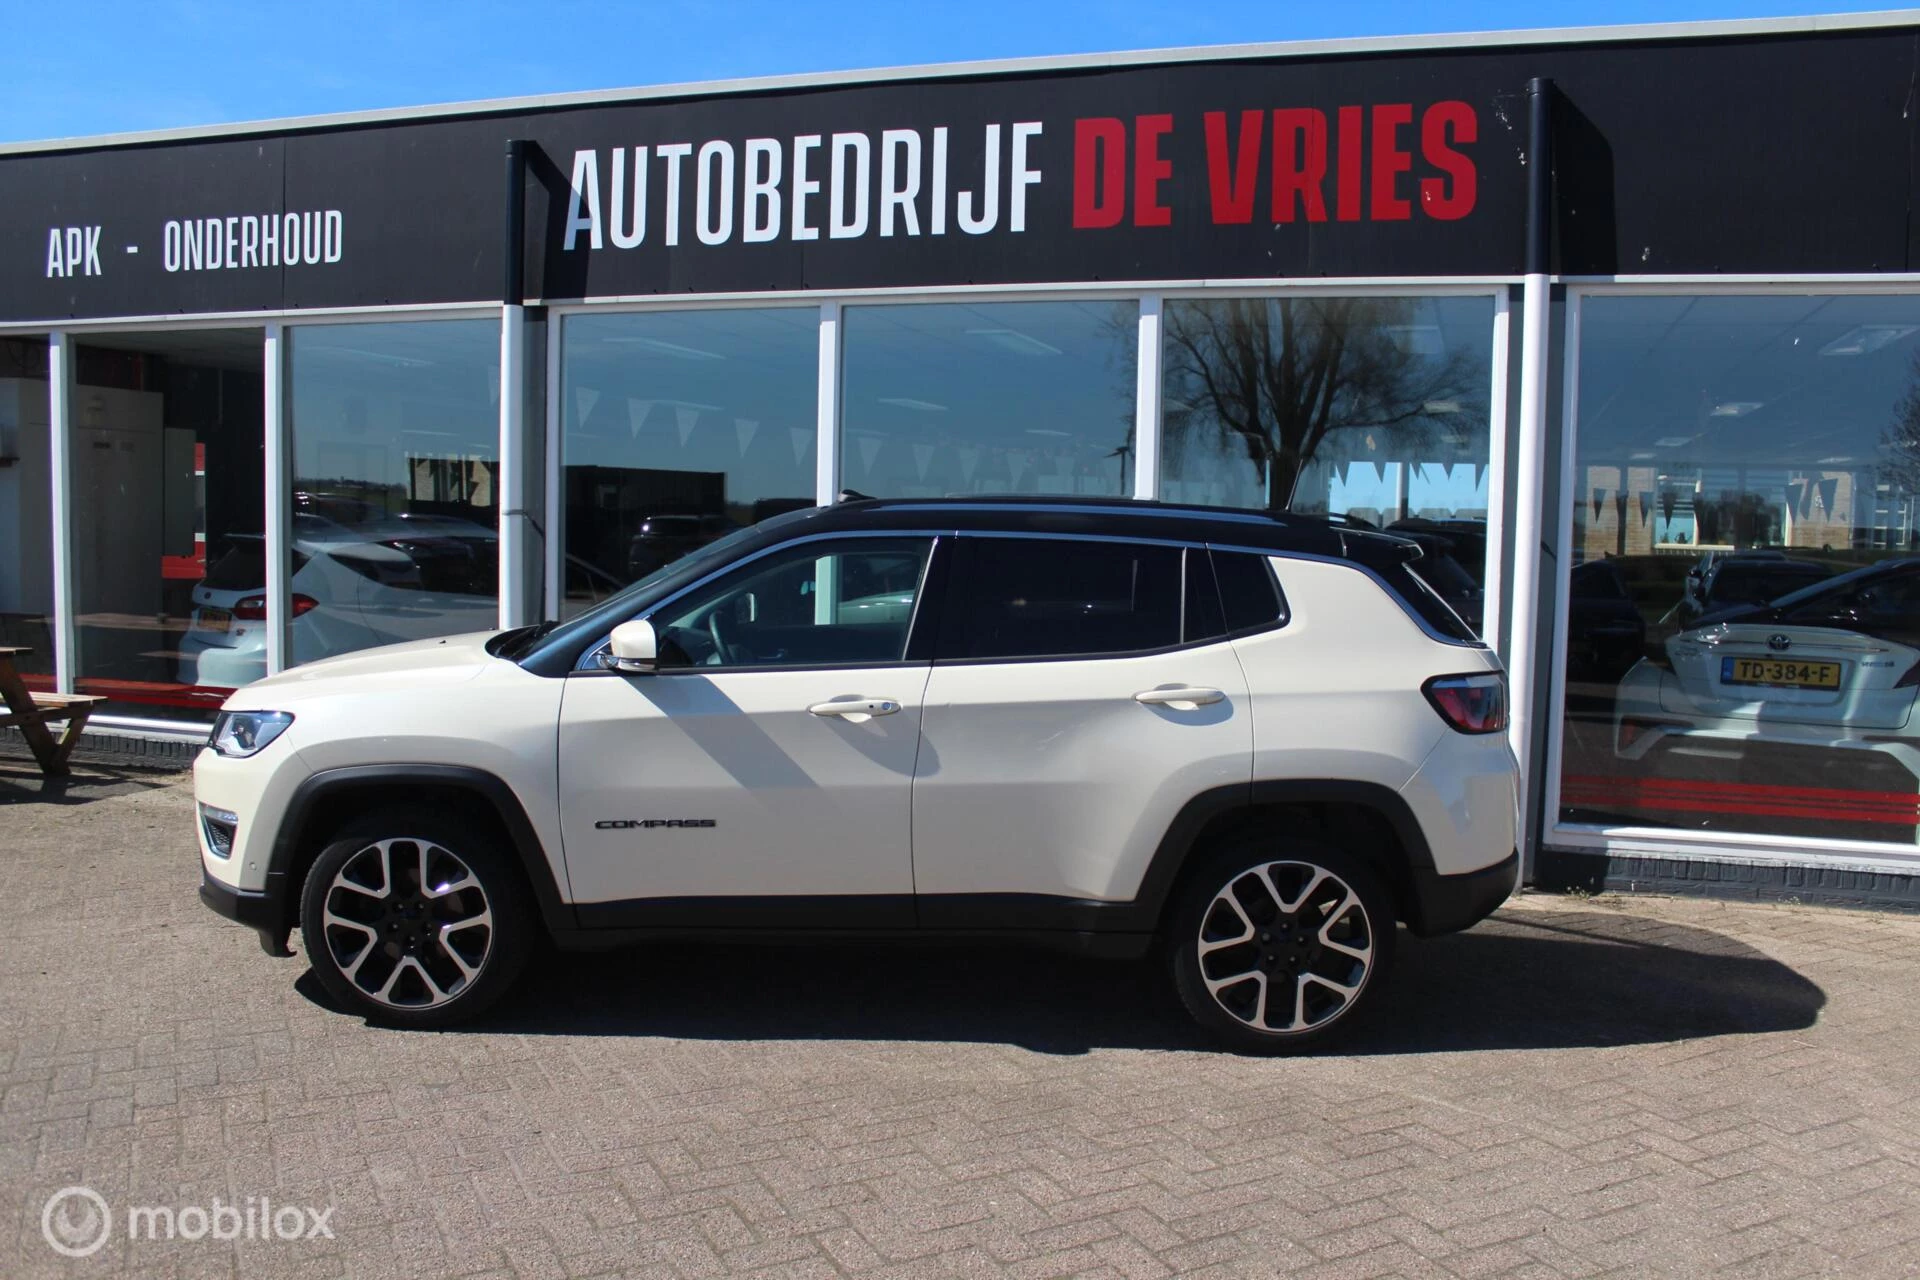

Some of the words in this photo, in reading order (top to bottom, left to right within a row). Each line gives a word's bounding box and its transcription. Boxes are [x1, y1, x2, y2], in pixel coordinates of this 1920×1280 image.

[563, 121, 1043, 251] AUTOBEDRIJF
[1073, 113, 1173, 229] DE
[1204, 100, 1478, 225] VRIES
[46, 225, 102, 278] APK
[163, 210, 343, 273] ONDERHOUD
[1740, 662, 1831, 683] TD-384-F
[595, 819, 717, 829] COMPASS
